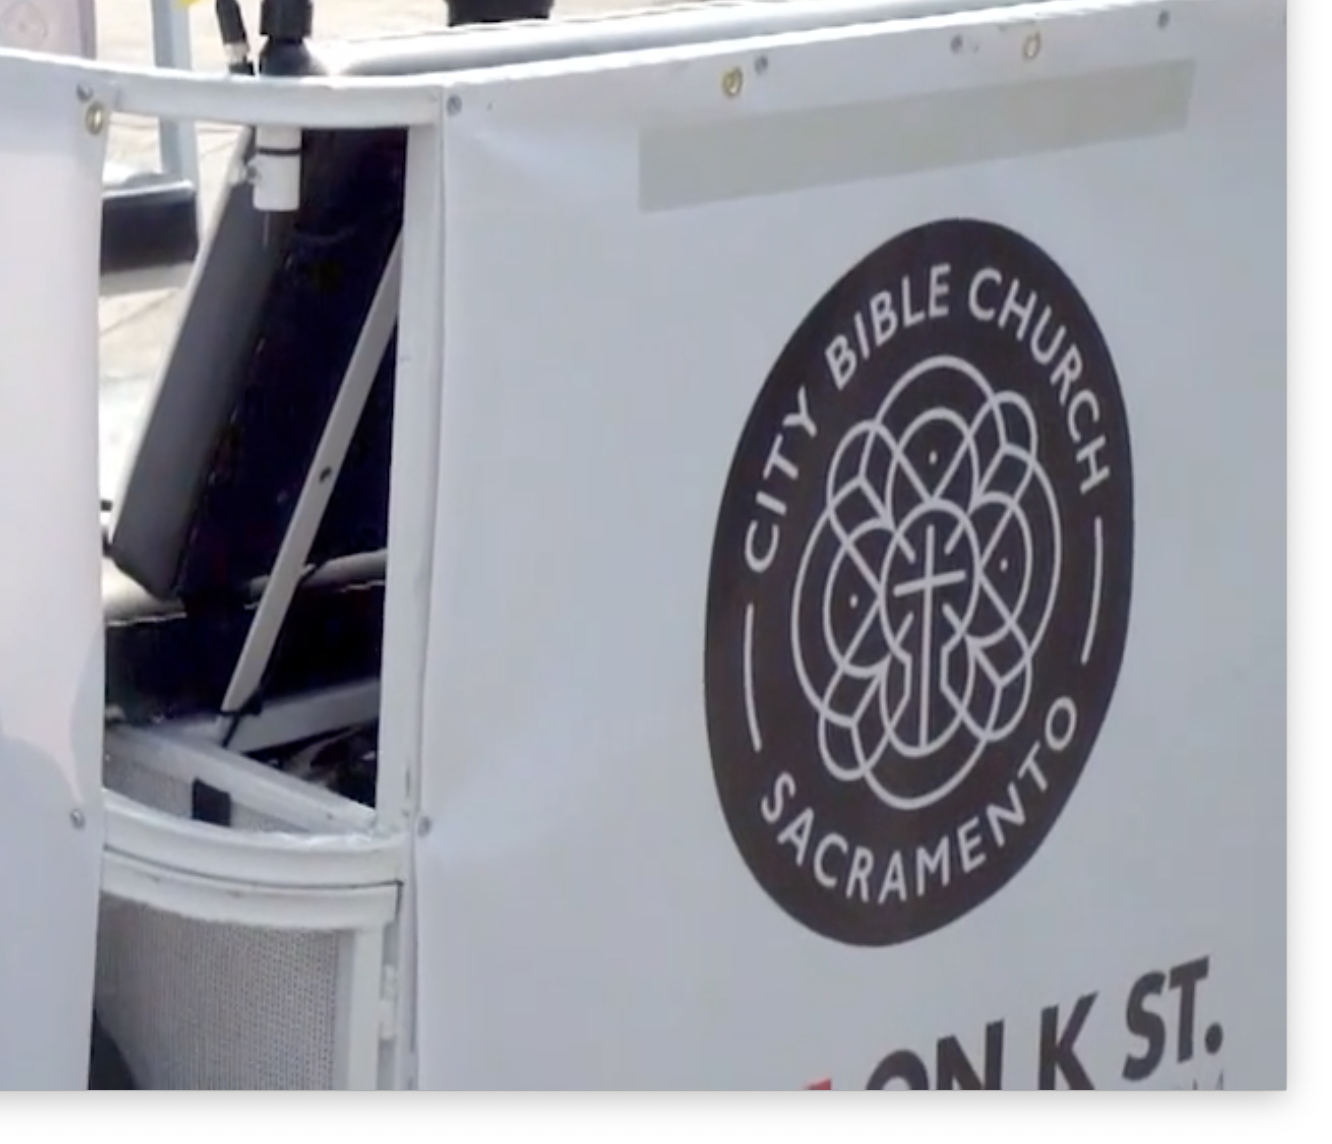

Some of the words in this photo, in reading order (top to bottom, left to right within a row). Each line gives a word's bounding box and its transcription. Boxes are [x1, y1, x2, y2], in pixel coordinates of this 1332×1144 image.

[744, 387, 818, 573] CITY
[824, 263, 950, 390] BIBLE
[967, 267, 1110, 495] CHURCH
[760, 696, 1078, 905] SACRAMENTO
[1039, 991, 1098, 1090] K
[1122, 956, 1224, 1082] ST.
